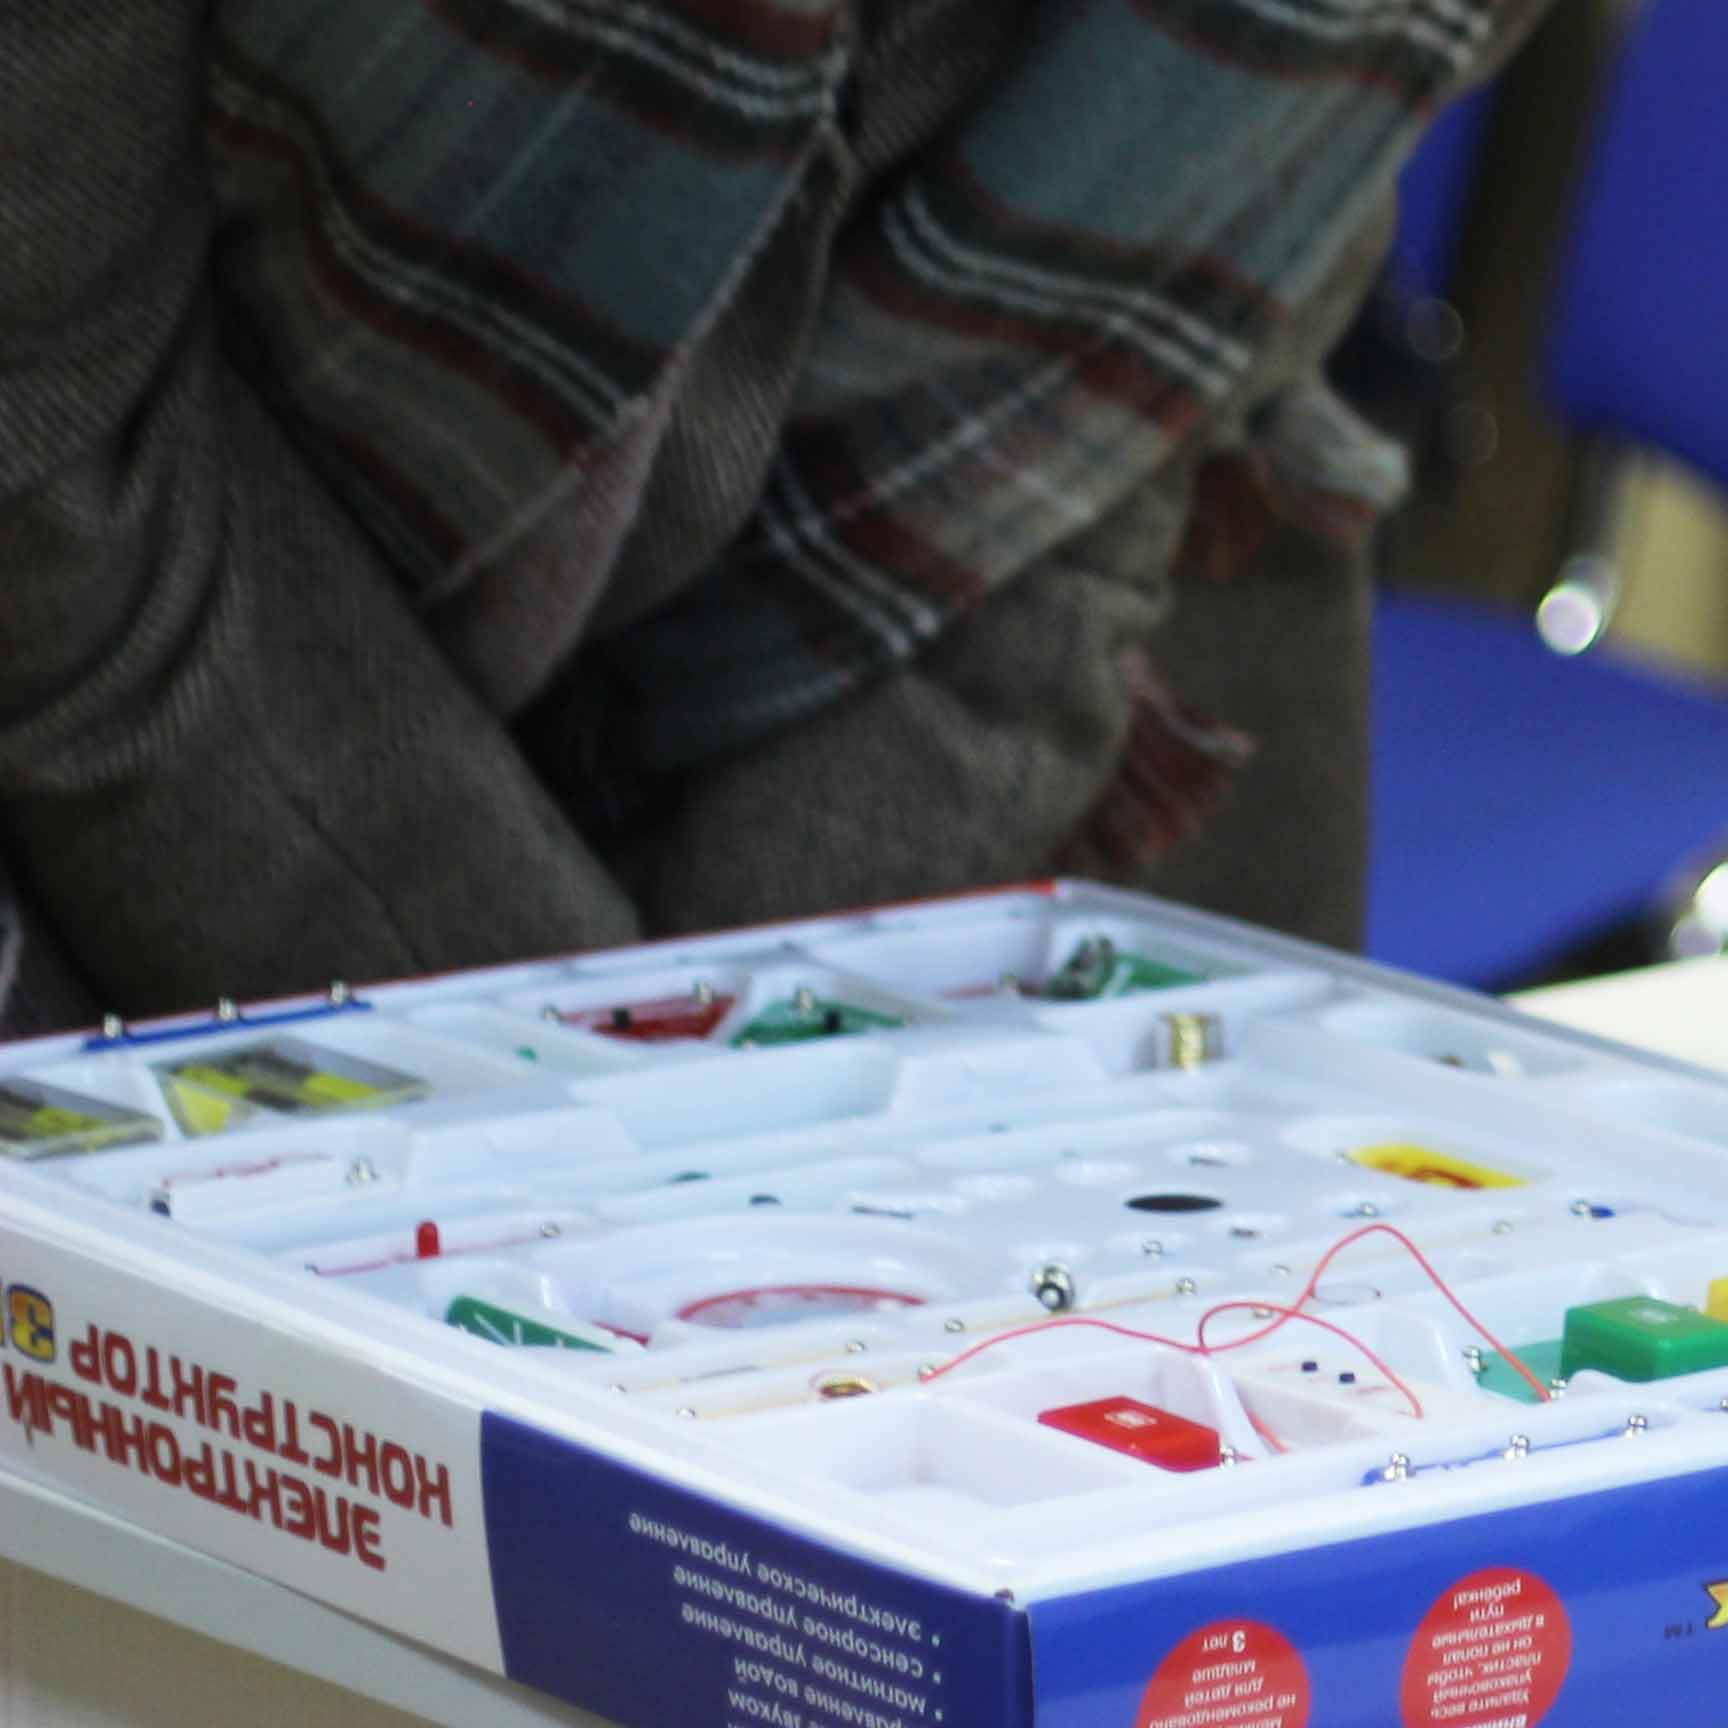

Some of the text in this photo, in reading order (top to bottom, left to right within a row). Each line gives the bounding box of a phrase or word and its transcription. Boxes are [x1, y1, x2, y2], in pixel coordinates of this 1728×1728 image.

[2, 1362, 387, 1573] ЭЛЕКТРОННЫЙ
[68, 1324, 454, 1530] КОНСТРУКТОР
[628, 1513, 921, 1642] электрическое управление
[673, 1565, 923, 1680] сенсорное управление
[682, 1603, 925, 1714] магнитное управление
[734, 1658, 798, 1697] водой
[1232, 1630, 1246, 1652] 3
